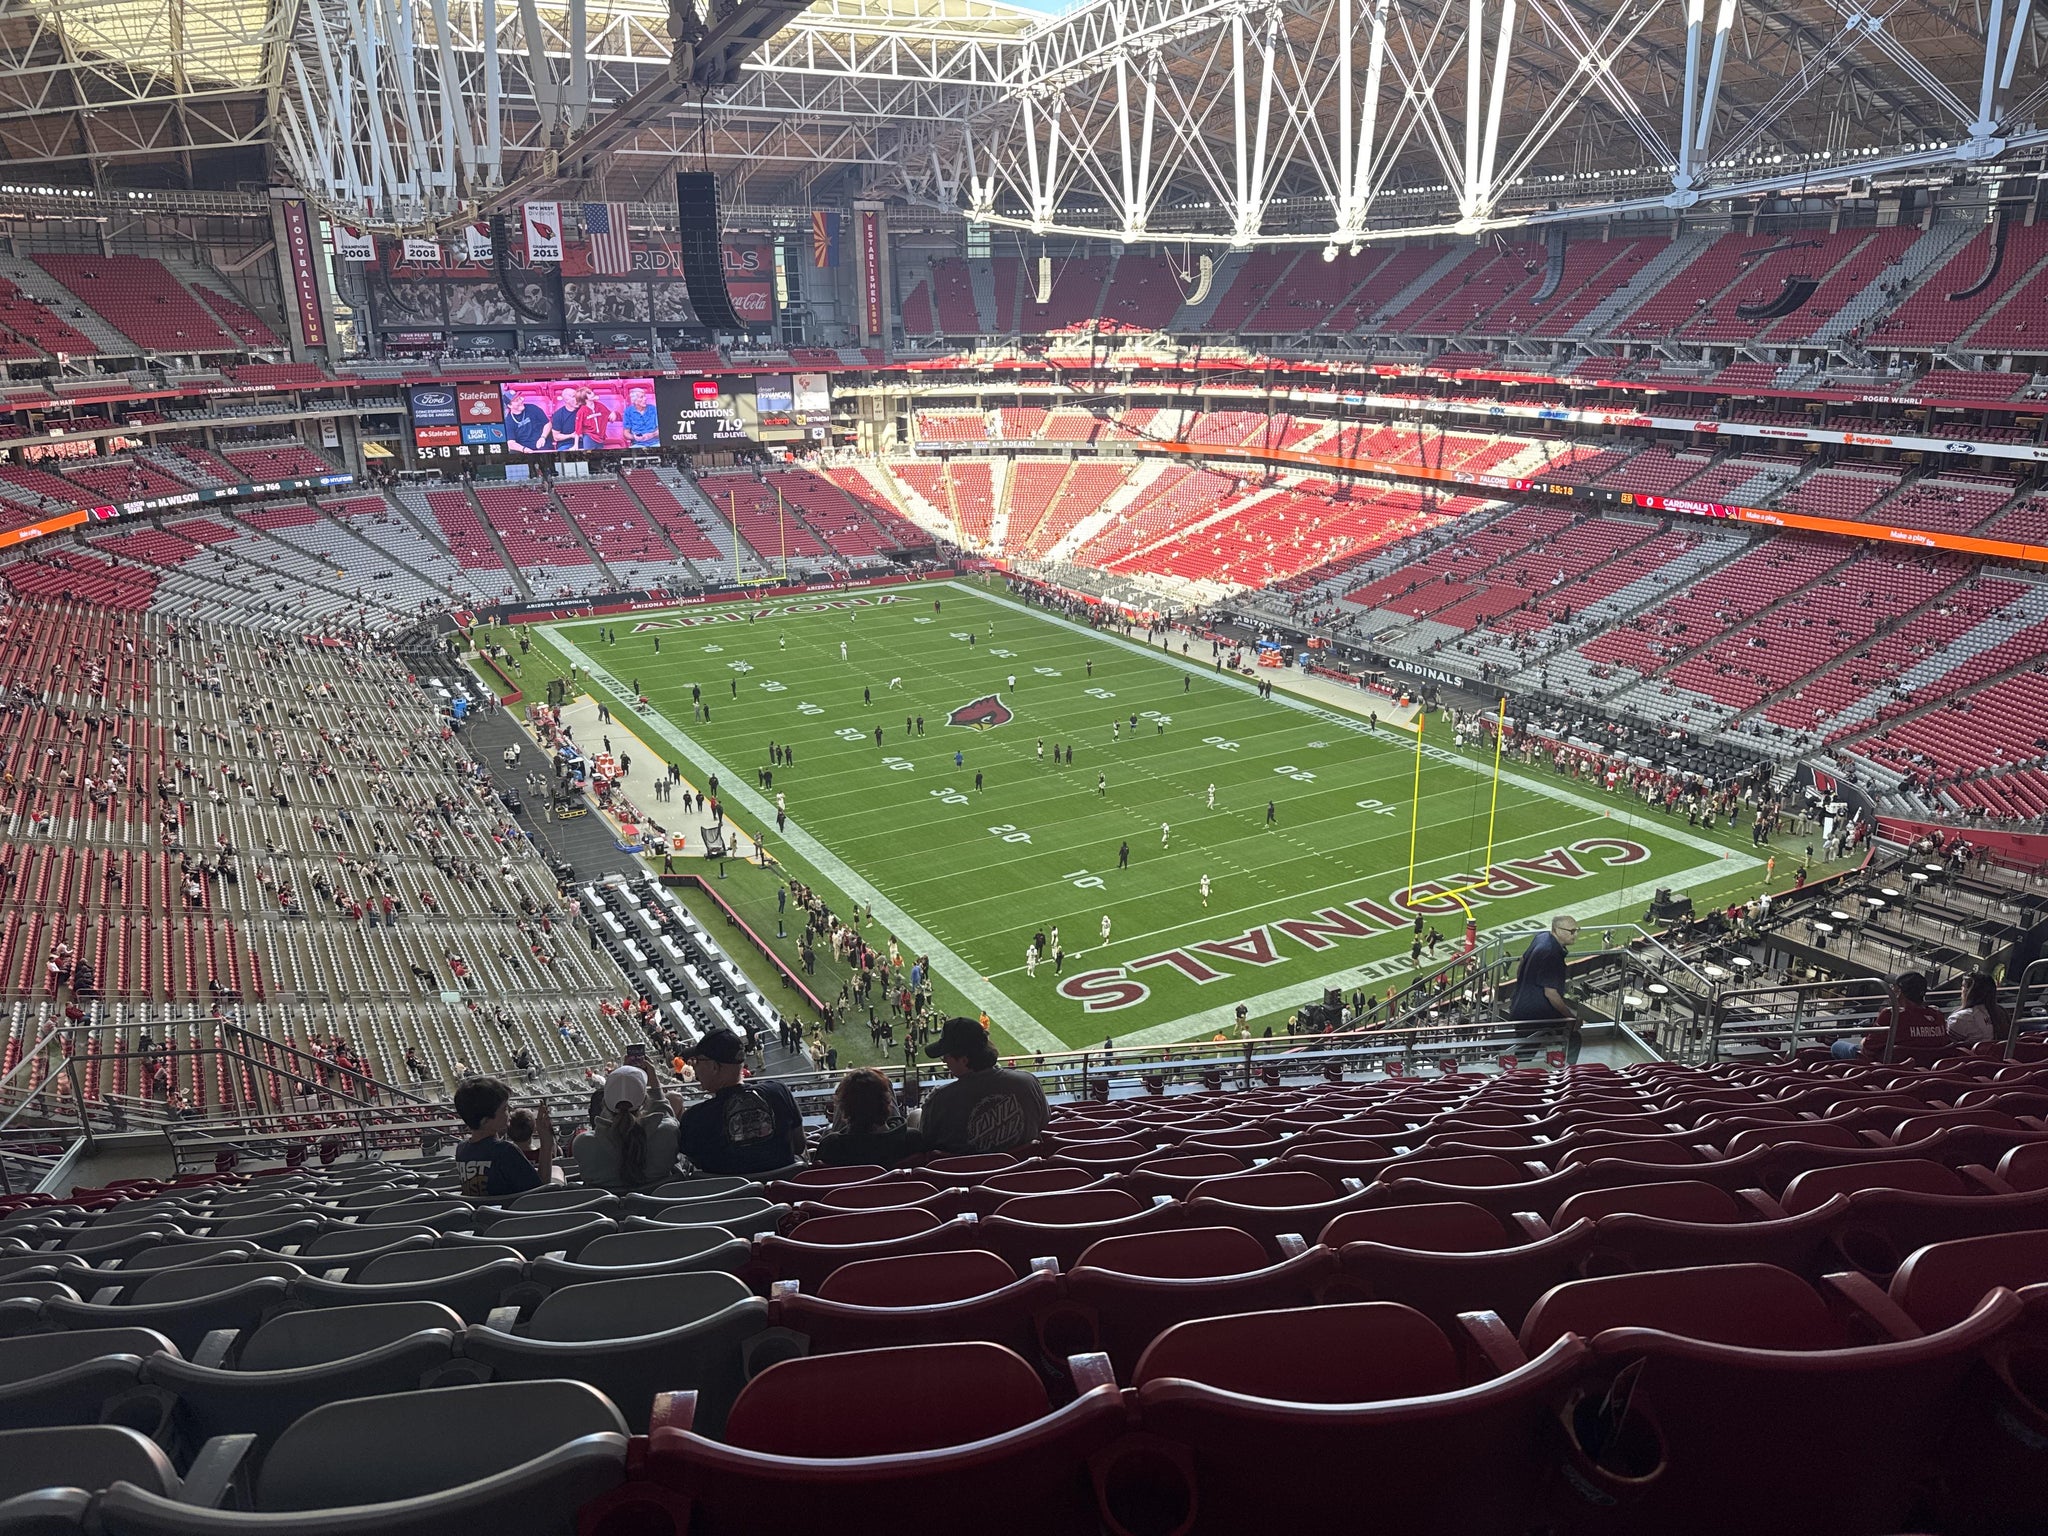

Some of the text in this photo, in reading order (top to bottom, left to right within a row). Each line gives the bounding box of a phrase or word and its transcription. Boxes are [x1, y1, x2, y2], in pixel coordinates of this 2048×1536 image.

[342, 249, 371, 258] 2008
[409, 249, 436, 258] 2008
[474, 249, 493, 258] 200
[533, 249, 559, 258] 2015
[586, 250, 760, 270] RDILS
[867, 224, 877, 303] ESTABLISHED
[292, 215, 319, 341] FOOTBALL CLUB
[694, 401, 719, 409] FIELD
[1862, 395, 1889, 403] ROGER
[680, 409, 735, 418] CONDITIONS
[806, 415, 830, 423] BETMGM
[677, 420, 695, 433] 71°
[763, 417, 790, 426] verizon
[672, 433, 697, 441] OUTSIDE
[417, 446, 451, 459] 55:18
[227, 487, 238, 495] 66
[265, 482, 280, 491] 766
[304, 479, 311, 487] 4
[1479, 475, 1508, 485] FALCONS
[1549, 484, 1574, 496] 55:18
[1646, 497, 1653, 506] 0
[1662, 499, 1709, 512] CARDINALS
[158, 493, 199, 508] M.WILSON
[1745, 511, 1760, 519] Make
[1765, 514, 1777, 523] play
[1889, 530, 1906, 540] Make
[1912, 534, 1927, 543] play
[1926, 538, 1936, 547] for
[836, 580, 870, 589] CADINALS
[526, 599, 590, 609] ARIZONA CARDINALS
[631, 601, 664, 610] ARIZONA
[630, 594, 922, 633] ARIZONA
[1388, 658, 1463, 686] CARDINALS
[1084, 688, 1116, 699] 50
[797, 703, 825, 715] 40
[834, 727, 867, 741] 50
[1308, 707, 1458, 761] INSPIRE CHANGE
[1201, 736, 1240, 750] 30
[881, 756, 914, 771] 40
[1273, 765, 1317, 782] 20
[930, 787, 969, 804] 30
[1355, 799, 1396, 815] 10
[987, 824, 1031, 843] 20
[1062, 869, 1104, 888] 10
[1055, 837, 1652, 1014] CARDINALS
[1972, 963, 1980, 973] 3
